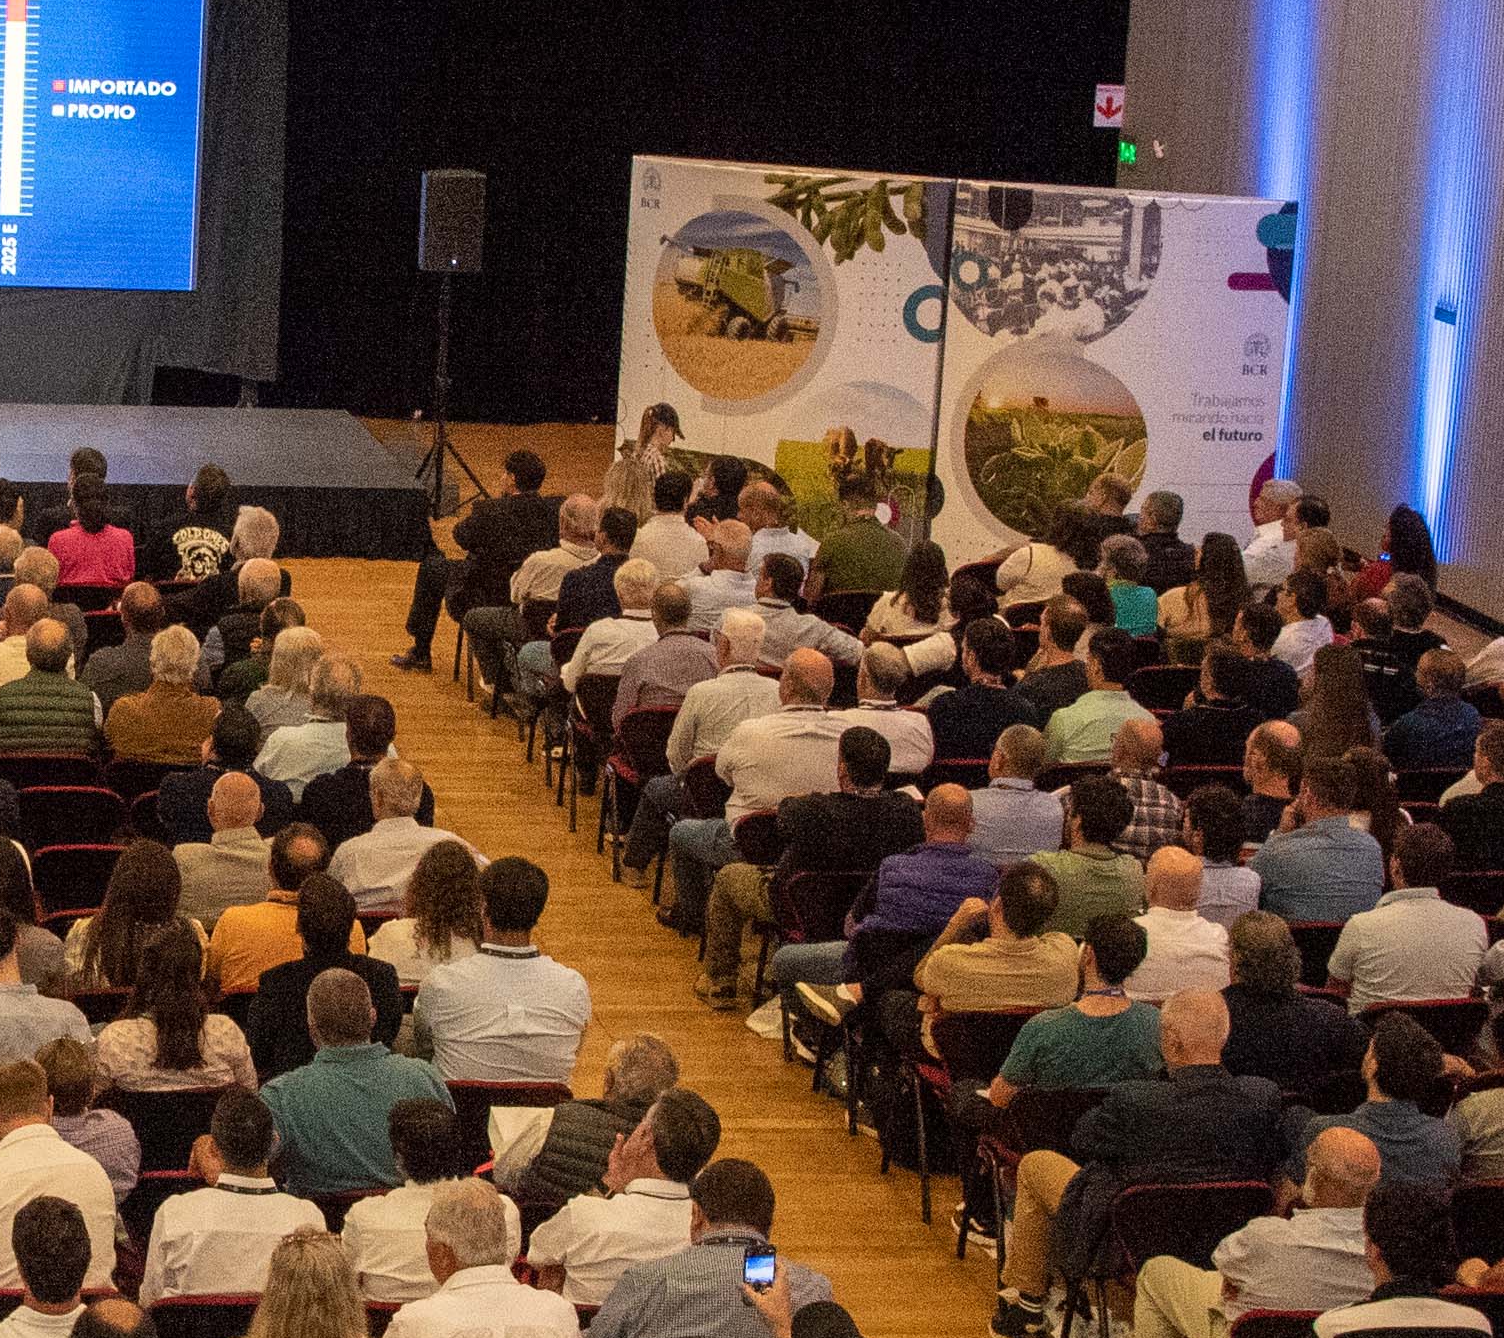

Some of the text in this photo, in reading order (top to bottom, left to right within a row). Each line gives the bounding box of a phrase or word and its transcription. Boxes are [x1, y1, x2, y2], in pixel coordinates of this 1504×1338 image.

[68, 79, 177, 96] IMPORTADO
[67, 103, 136, 119] PROPIO
[1, 223, 18, 276] 2025 E
[1202, 428, 1263, 441] el futuro
